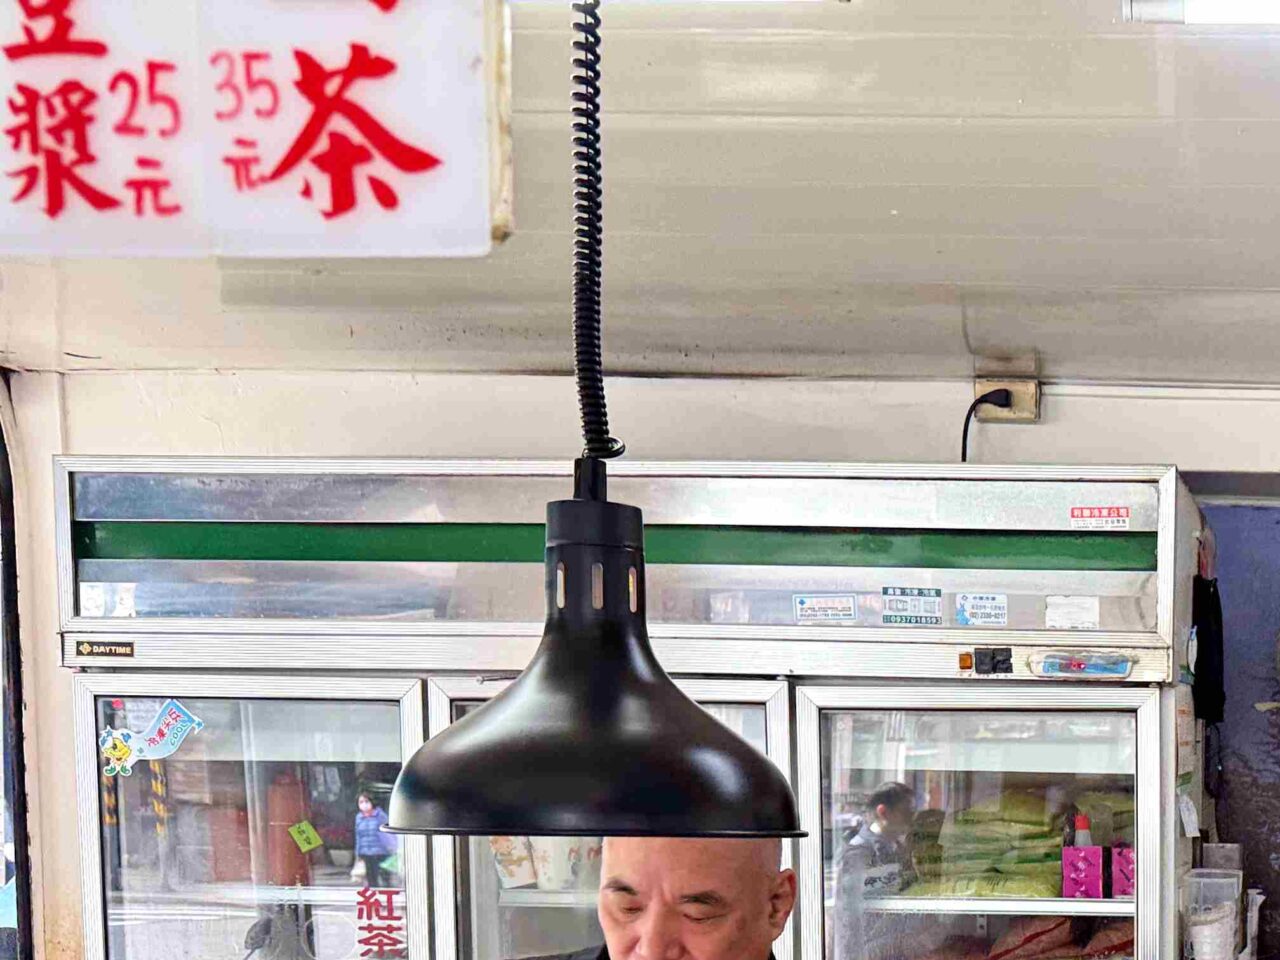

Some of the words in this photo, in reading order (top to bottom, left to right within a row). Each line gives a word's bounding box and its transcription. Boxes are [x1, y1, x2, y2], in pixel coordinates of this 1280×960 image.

[267, 0, 443, 219] 茶
[92, 646, 132, 654] DAYTIME
[356, 886, 407, 959] 紅茶
